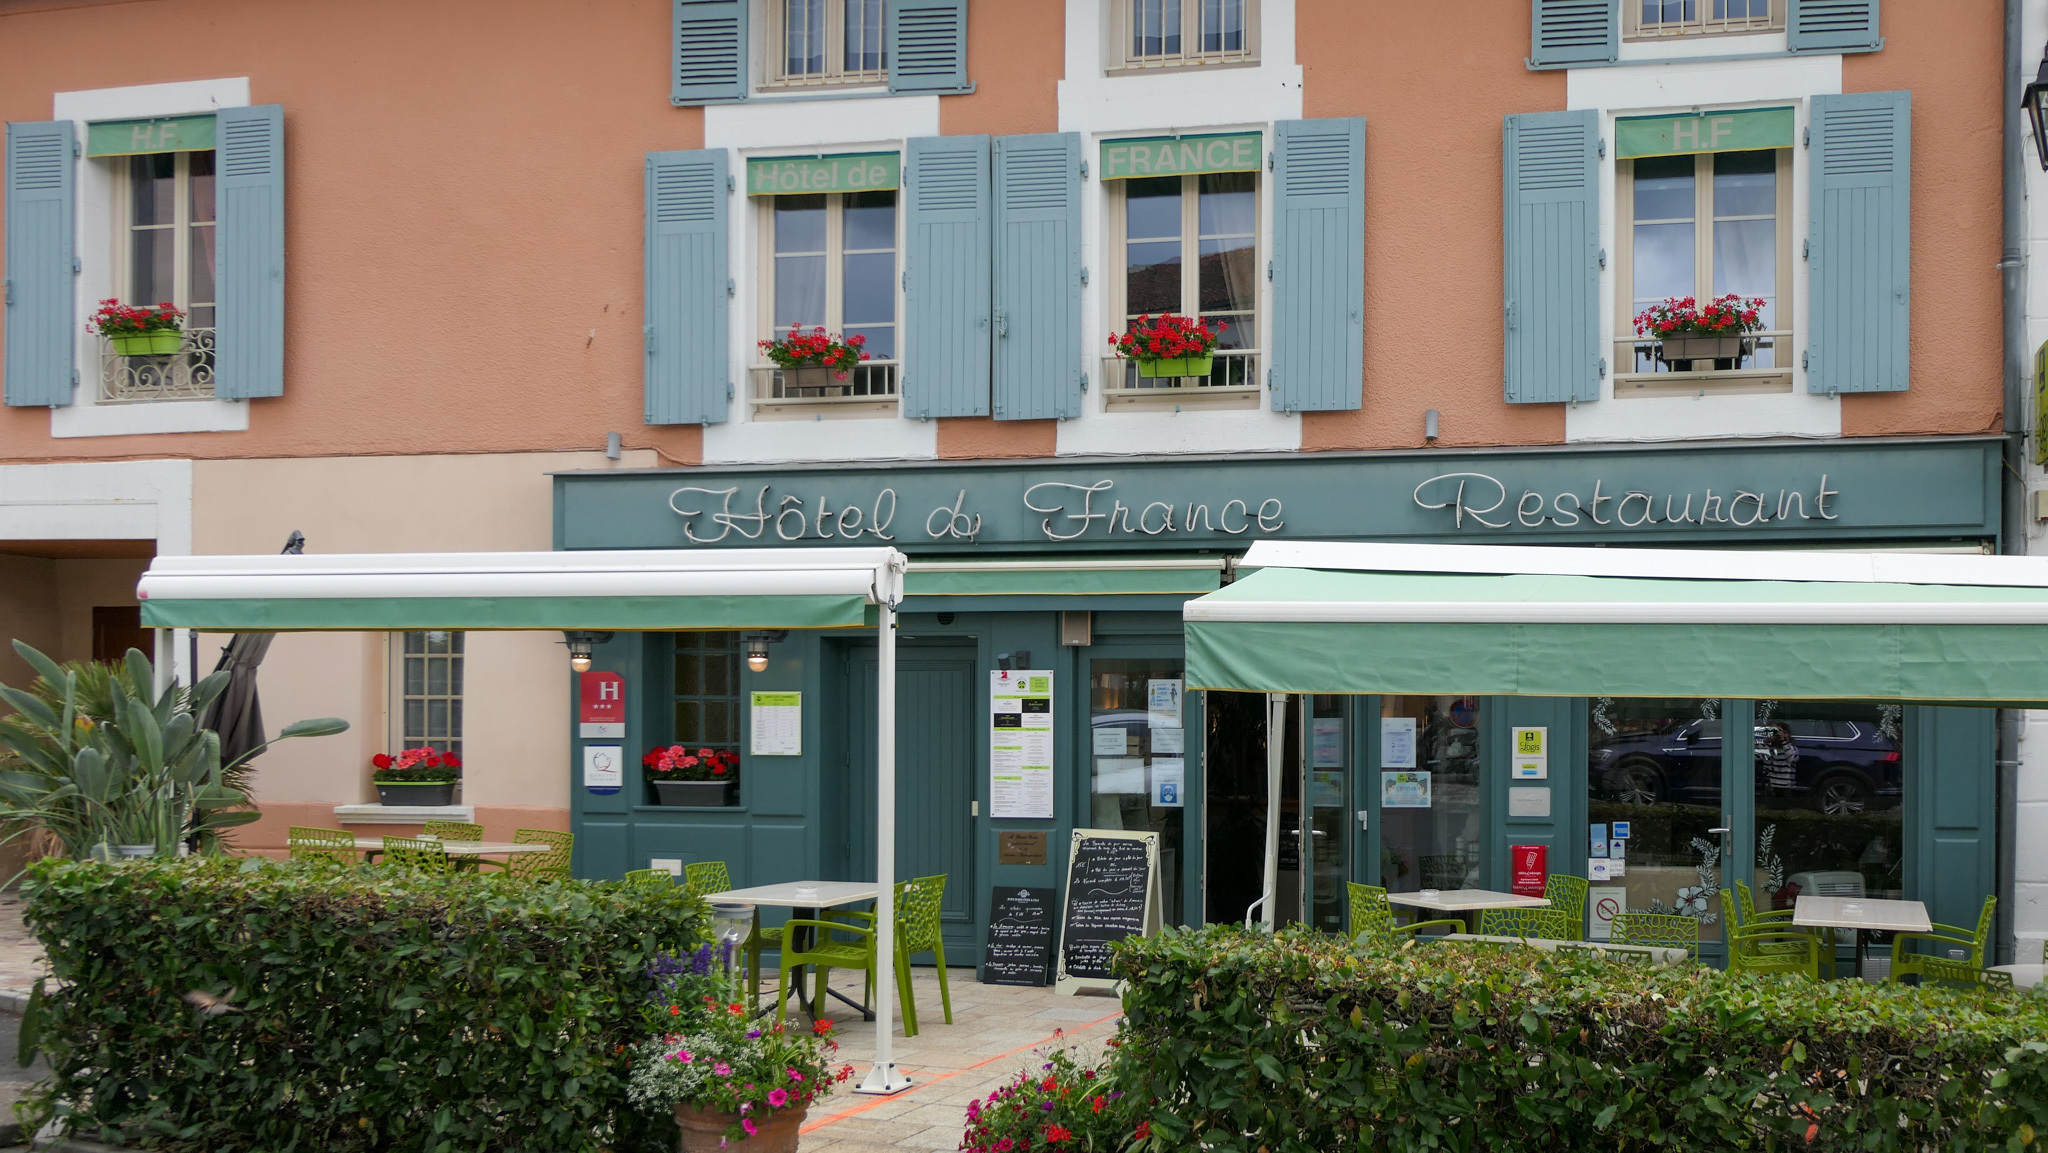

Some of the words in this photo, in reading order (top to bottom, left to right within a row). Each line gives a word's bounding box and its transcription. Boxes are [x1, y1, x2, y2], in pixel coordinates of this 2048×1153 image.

[1108, 139, 1254, 175] FRANCE
[755, 162, 838, 190] Hôtel
[848, 160, 887, 187] de
[670, 485, 897, 543] Hôtel
[1023, 479, 1285, 540] France
[1413, 472, 1839, 530] Restaurant
[599, 681, 620, 701] H
[1519, 740, 1540, 753] Logis
